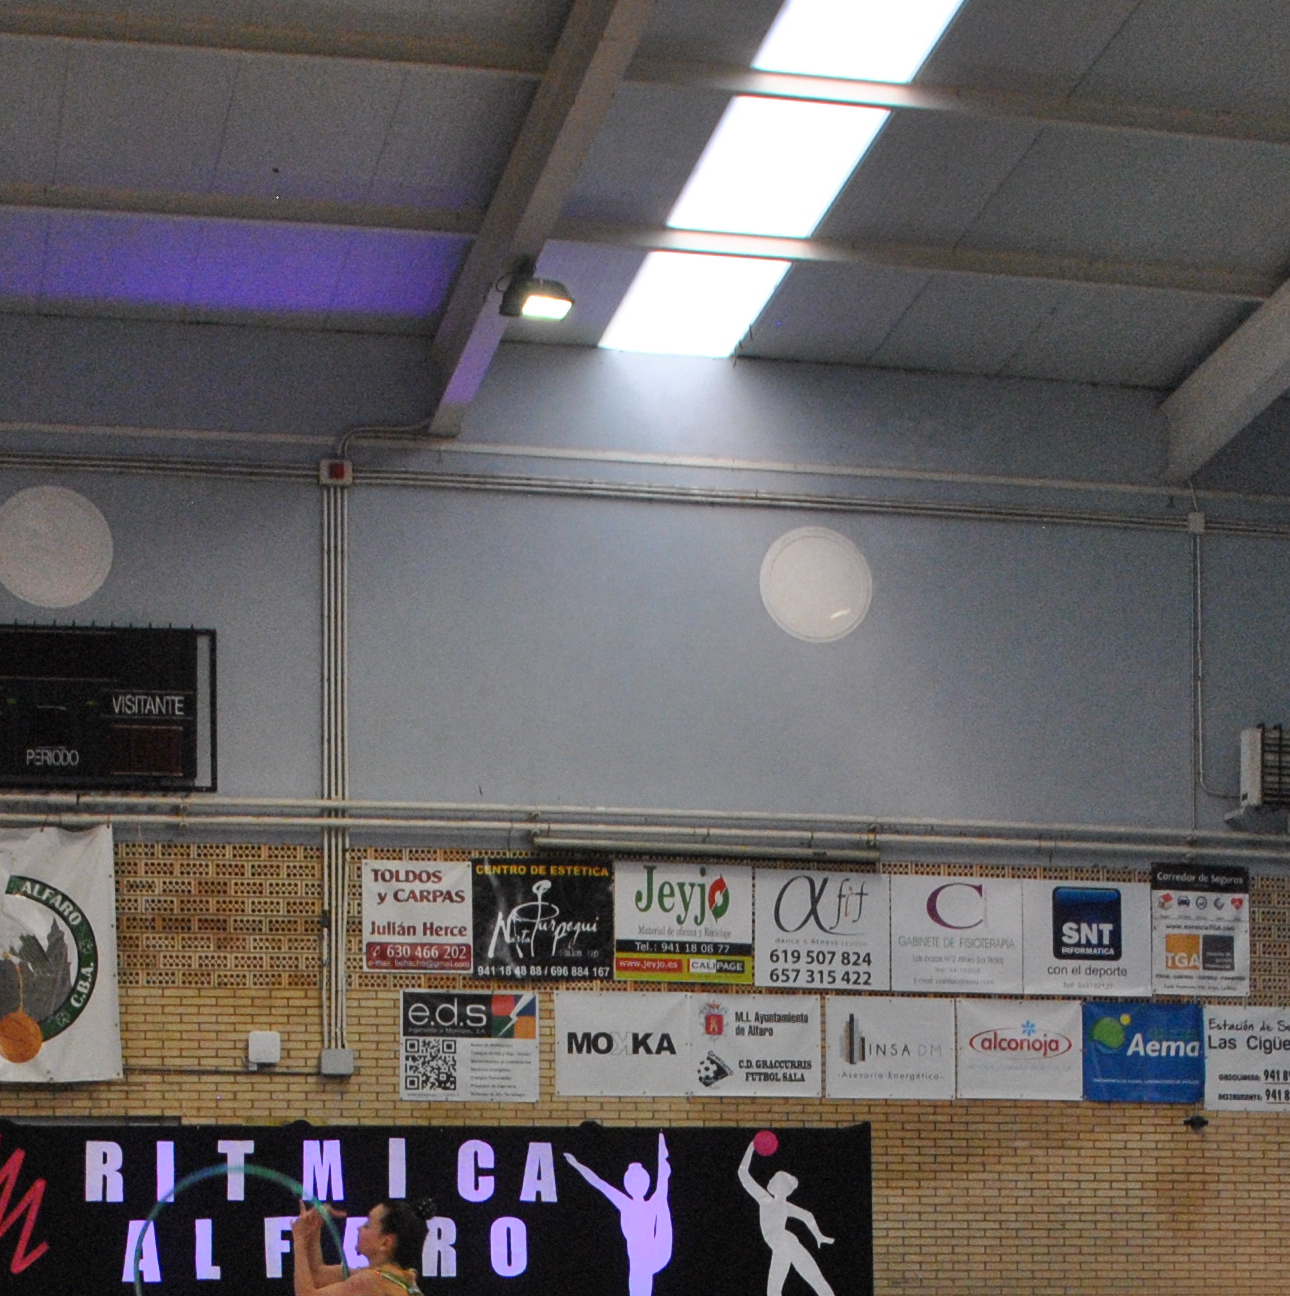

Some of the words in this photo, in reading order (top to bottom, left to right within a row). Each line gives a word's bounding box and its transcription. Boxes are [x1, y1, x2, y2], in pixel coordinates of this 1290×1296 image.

[112, 695, 184, 715] VISITANTE
[26, 749, 79, 766] PERIODO
[371, 869, 442, 883] TOLDOS
[476, 864, 526, 875] CENTRO
[531, 865, 547, 875] DE
[1157, 872, 1196, 881] Corredor
[1198, 873, 1209, 882] de
[1211, 874, 1244, 885] Seguros
[21, 880, 82, 925] ALFARO
[377, 892, 387, 905] y
[393, 889, 466, 904] CARPAS
[370, 921, 416, 936] Julián
[423, 922, 467, 937] Herce
[1062, 922, 1113, 944] SNT
[661, 943, 679, 952] 941
[685, 943, 697, 953] 18
[717, 944, 730, 953] 77
[898, 935, 940, 947] GABINETE
[943, 937, 954, 947] DE
[959, 938, 1015, 949] FISIOTERAPIA
[386, 945, 410, 958] 630
[415, 945, 439, 958] 466
[444, 946, 466, 958] 202
[769, 949, 801, 964] 619
[805, 950, 836, 965] 507
[841, 951, 872, 966] 824
[619, 960, 678, 970] www.jeyjo.es
[1166, 953, 1201, 968] TGA
[477, 966, 495, 976] 941
[500, 966, 511, 976] 18
[514, 966, 526, 976] 48
[530, 966, 542, 976] 88
[571, 966, 589, 977] 884
[593, 967, 609, 977] 167
[769, 968, 801, 983] 657
[806, 969, 836, 985] 315
[841, 971, 872, 986] 422
[1047, 966, 1068, 975] con
[1072, 965, 1081, 974] el
[1085, 965, 1127, 978] deporte
[408, 997, 487, 1027] e.d.s
[754, 1012, 809, 1024] Ayuntamiento
[735, 1026, 745, 1036] de
[748, 1025, 774, 1036] Alfaro
[1209, 1018, 1254, 1031] Estación
[1259, 1021, 1273, 1031] de
[981, 1031, 1059, 1057] alconoja
[1126, 1033, 1200, 1057] Aema
[1208, 1036, 1237, 1050] Las
[869, 1044, 910, 1056] INSA
[918, 1044, 942, 1056] DM
[738, 1060, 753, 1069] C.D.
[745, 1072, 781, 1081] FUTBOL
[782, 1073, 806, 1082] SALA
[1264, 1070, 1280, 1081] 941
[1265, 1089, 1282, 1101] 941
